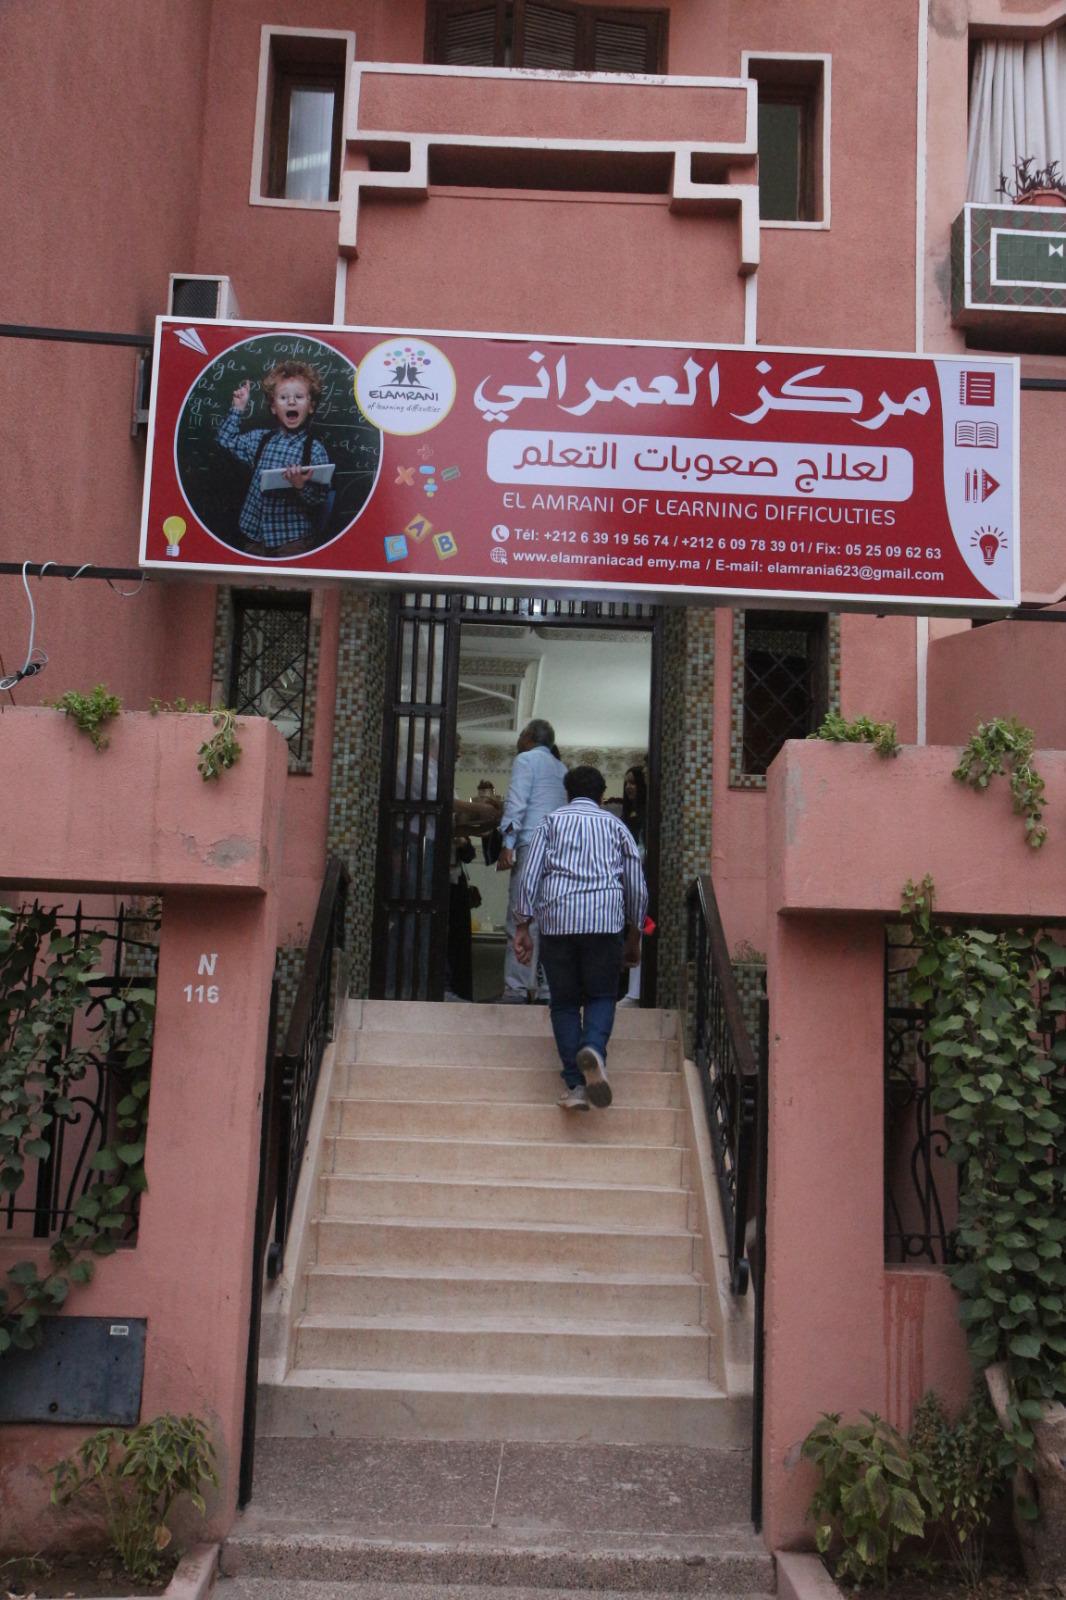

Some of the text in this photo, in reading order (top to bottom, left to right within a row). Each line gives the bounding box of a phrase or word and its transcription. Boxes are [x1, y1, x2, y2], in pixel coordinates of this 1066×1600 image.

[369, 390, 439, 401] ELAMRANI
[473, 351, 931, 430] مركز العمراني
[513, 439, 888, 493] لعلاج صعوبات التعلم
[503, 492, 896, 526] EL AMRANI OF LEARNING DIFFICULTIES
[438, 535, 454, 553] B
[514, 528, 539, 542] Tél:
[544, 531, 577, 544] +212
[580, 532, 589, 543] 6
[593, 532, 609, 544] 39
[614, 533, 629, 545] 19
[633, 534, 649, 546] 56
[654, 535, 669, 547] 74
[681, 536, 714, 549] +212
[718, 537, 726, 549] 6
[730, 538, 746, 550] 09
[750, 539, 766, 551] 78
[770, 540, 786, 552] 39
[816, 542, 841, 555] Fix:
[845, 544, 861, 556] 05
[865, 545, 881, 556] 25
[885, 546, 902, 557] 09
[905, 547, 921, 558] 62
[925, 548, 942, 559] 63
[647, 558, 701, 572] emy.ma
[706, 558, 711, 571] /
[715, 559, 763, 573] E-mail:
[767, 561, 945, 581] elamrania623@gmail.com
[198, 953, 218, 976] N
[183, 984, 219, 1004] 116
